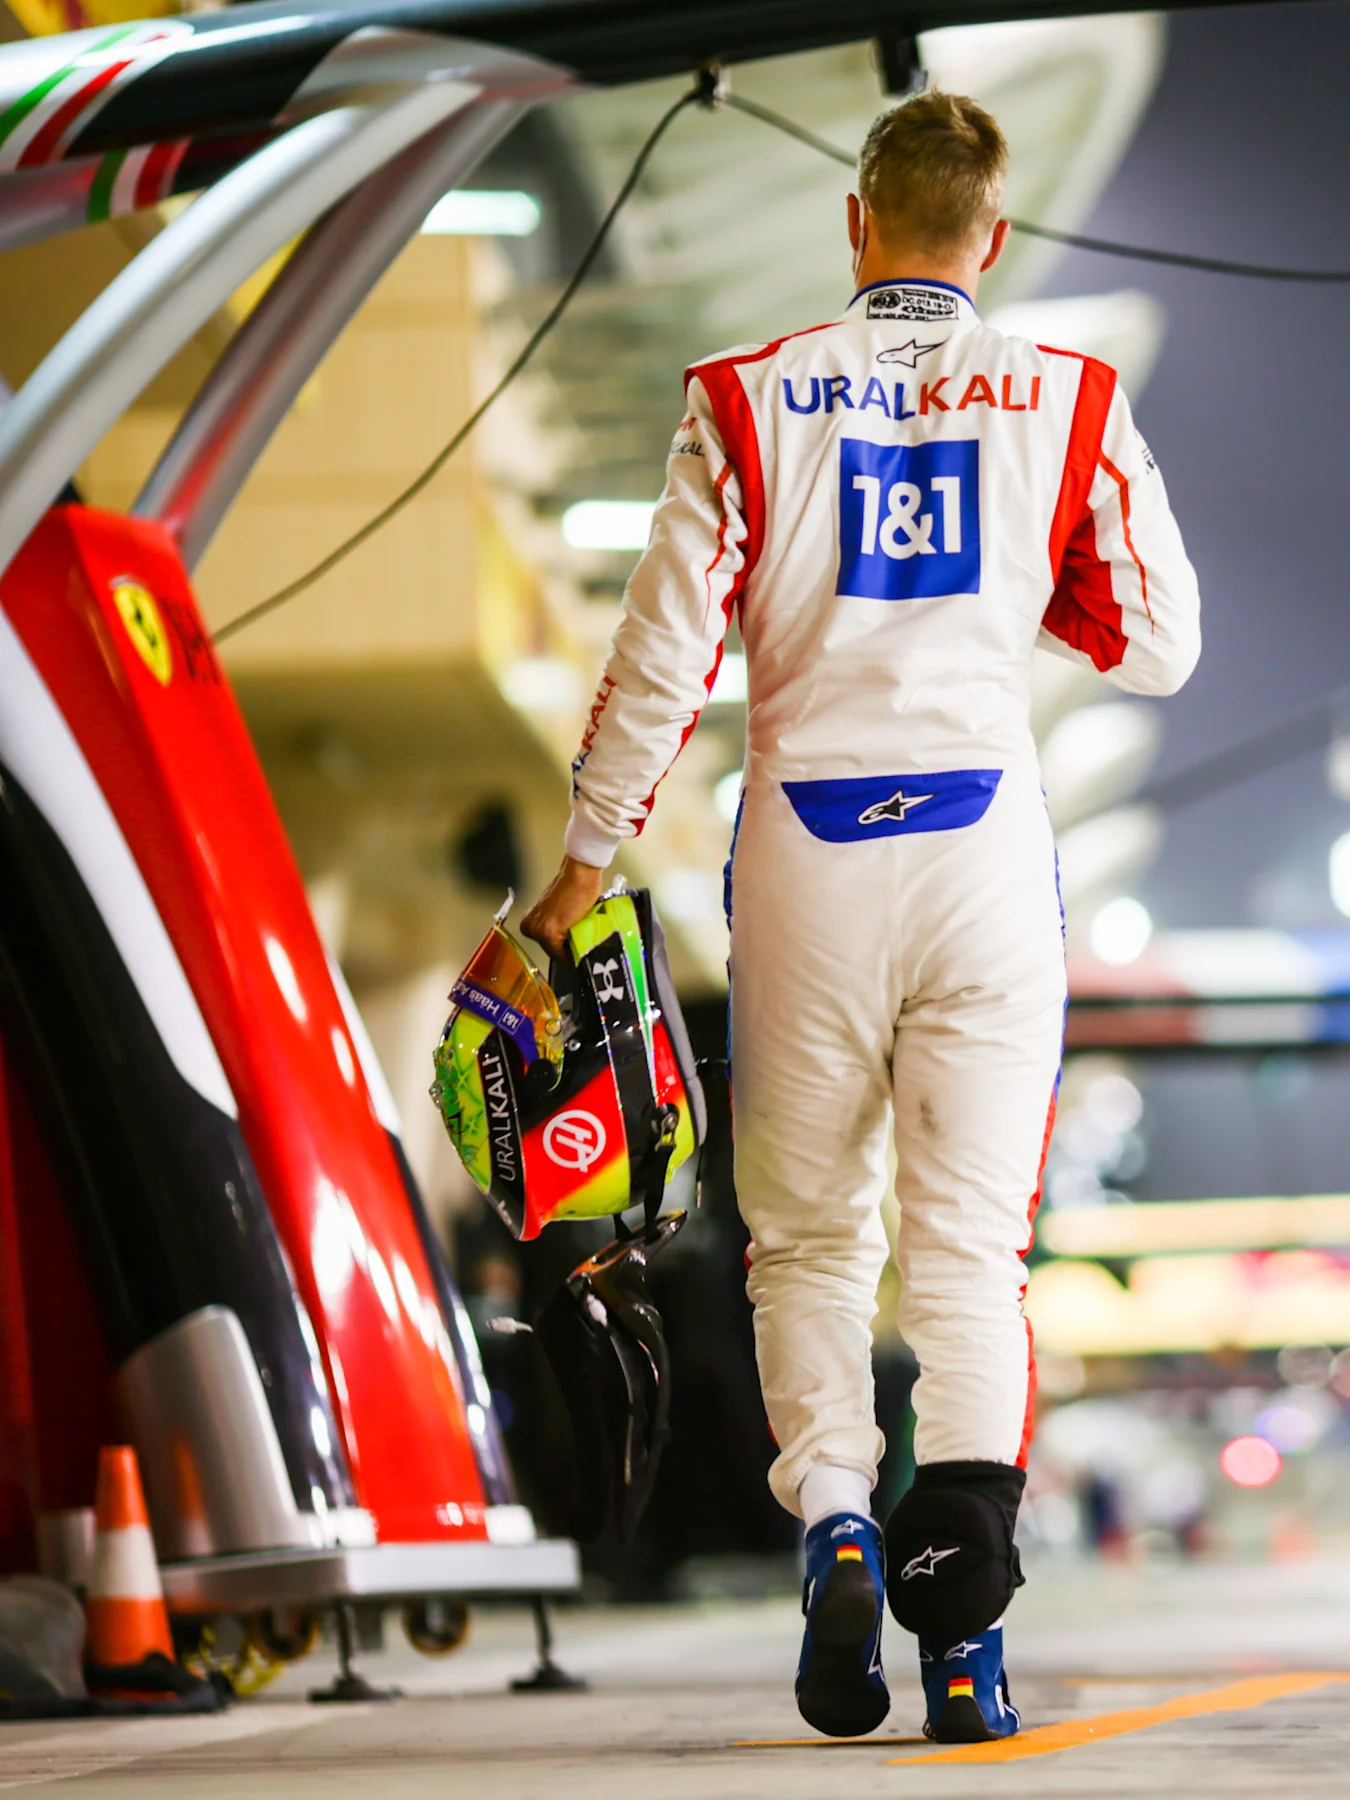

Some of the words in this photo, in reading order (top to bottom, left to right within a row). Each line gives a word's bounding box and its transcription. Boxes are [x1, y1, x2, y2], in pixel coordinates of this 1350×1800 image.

[783, 374, 1041, 421] URALKALI
[852, 475, 962, 560] 1&1
[469, 990, 500, 1017] Haas
[481, 1053, 515, 1182] URALKALI
